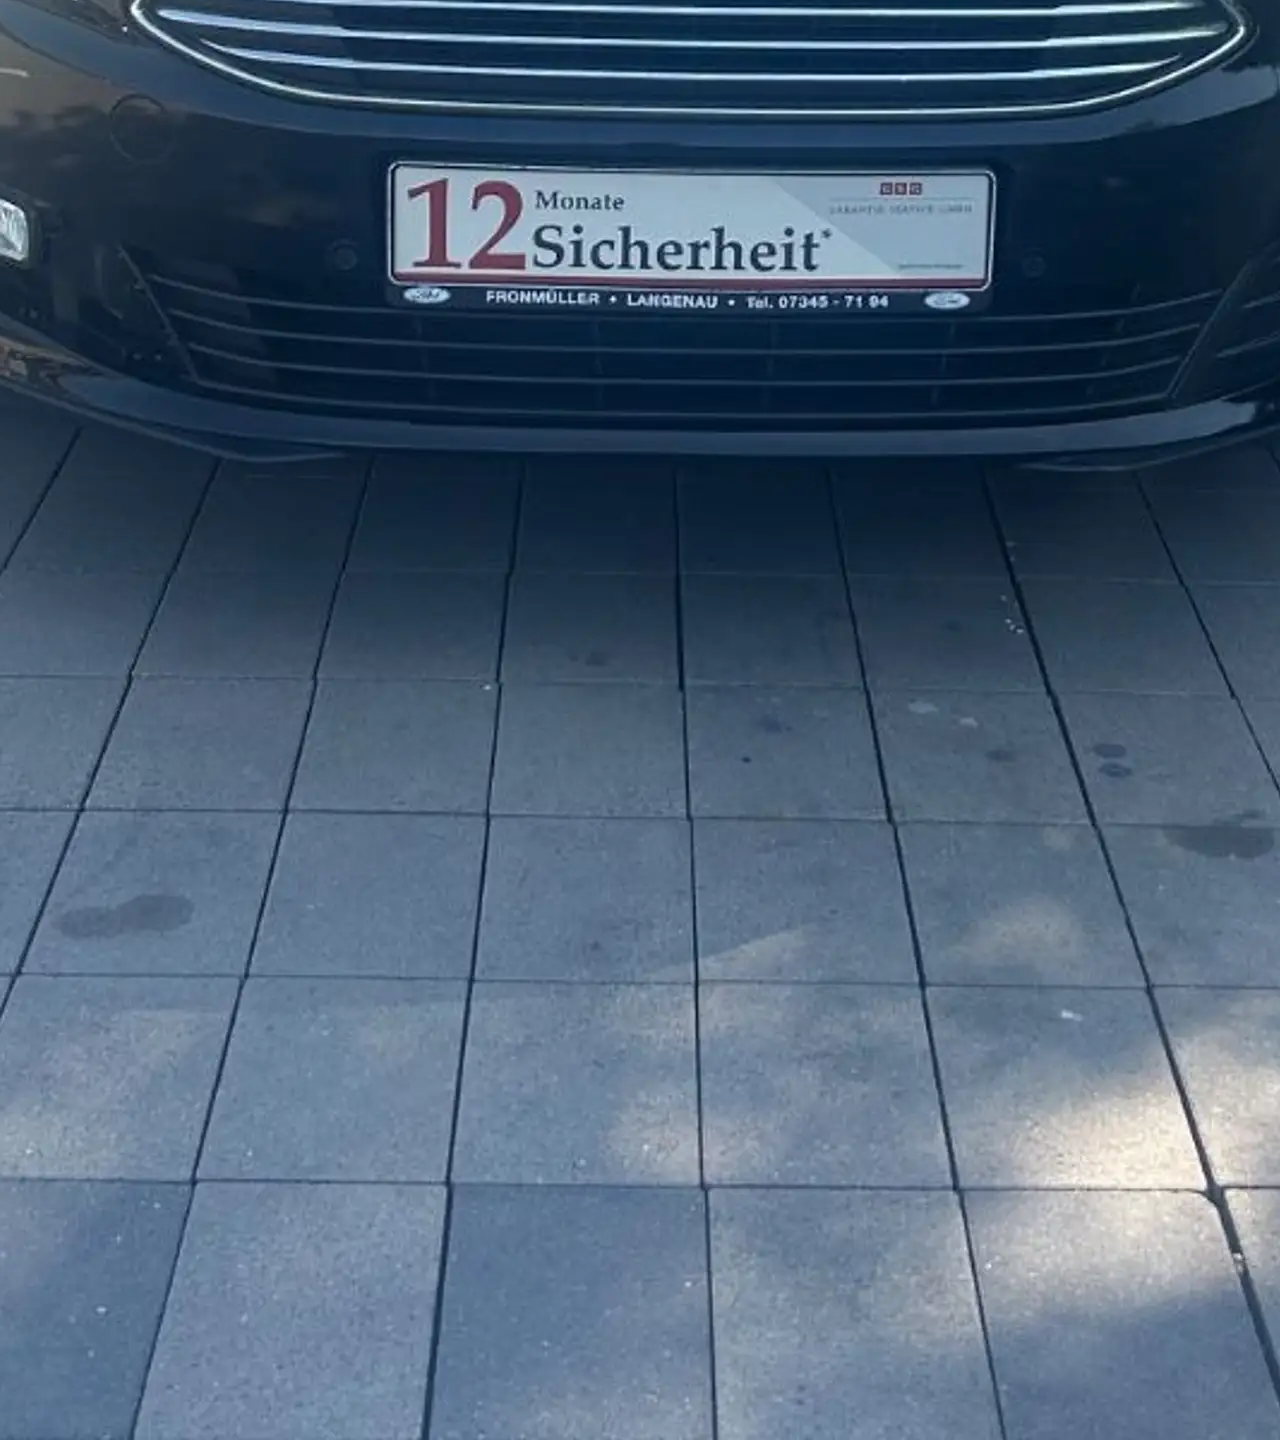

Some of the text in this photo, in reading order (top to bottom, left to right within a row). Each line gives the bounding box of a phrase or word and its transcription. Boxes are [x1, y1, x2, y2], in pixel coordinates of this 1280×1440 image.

[534, 189, 625, 211] Monate
[407, 178, 526, 270] 12
[485, 289, 600, 306] FRONMÜLLER
[626, 292, 718, 308] LANGENAU
[746, 294, 774, 309] Tel.
